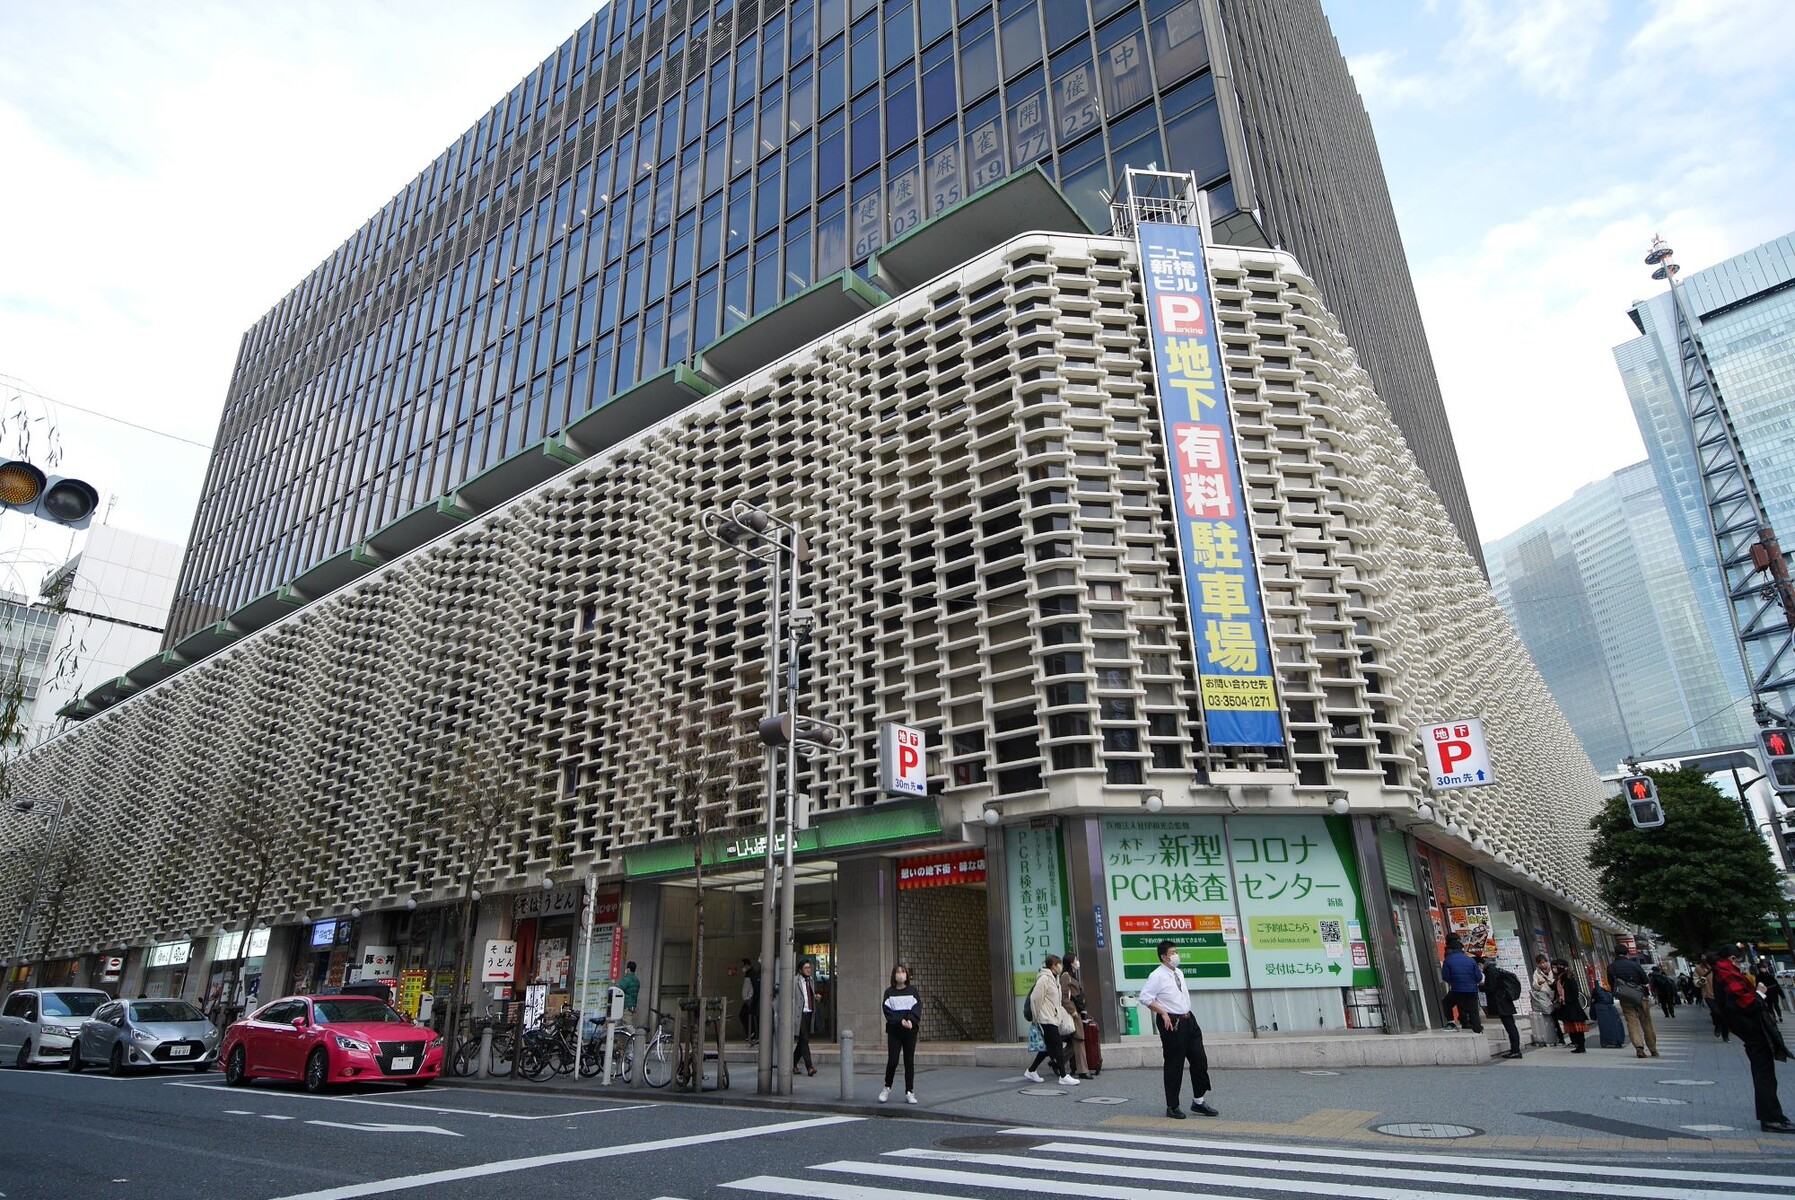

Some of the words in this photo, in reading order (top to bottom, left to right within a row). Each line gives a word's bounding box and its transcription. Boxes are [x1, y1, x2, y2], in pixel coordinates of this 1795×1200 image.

[855, 230, 878, 256] 6F
[894, 209, 917, 234] 03
[934, 184, 959, 213] 35
[974, 160, 1001, 188] 19
[1018, 132, 1046, 162] 77
[1065, 103, 1094, 136] 25
[1149, 246, 1194, 258] ニュー
[1150, 259, 1196, 277] 新橋
[1154, 277, 1198, 293] ビル
[1205, 678, 1268, 690] お問い合わせ先
[898, 730, 918, 745] 地下
[1434, 725, 1468, 740] 地下
[899, 745, 919, 778] P
[1437, 741, 1472, 774] P
[1120, 838, 1143, 851] 木下
[1109, 853, 1157, 866] グループ
[1327, 897, 1344, 907] 新橋
[1256, 922, 1310, 933] ご予約はこちら
[490, 944, 515, 955] そば
[488, 957, 514, 968] うどん
[1265, 962, 1324, 975] 受付はこちら
